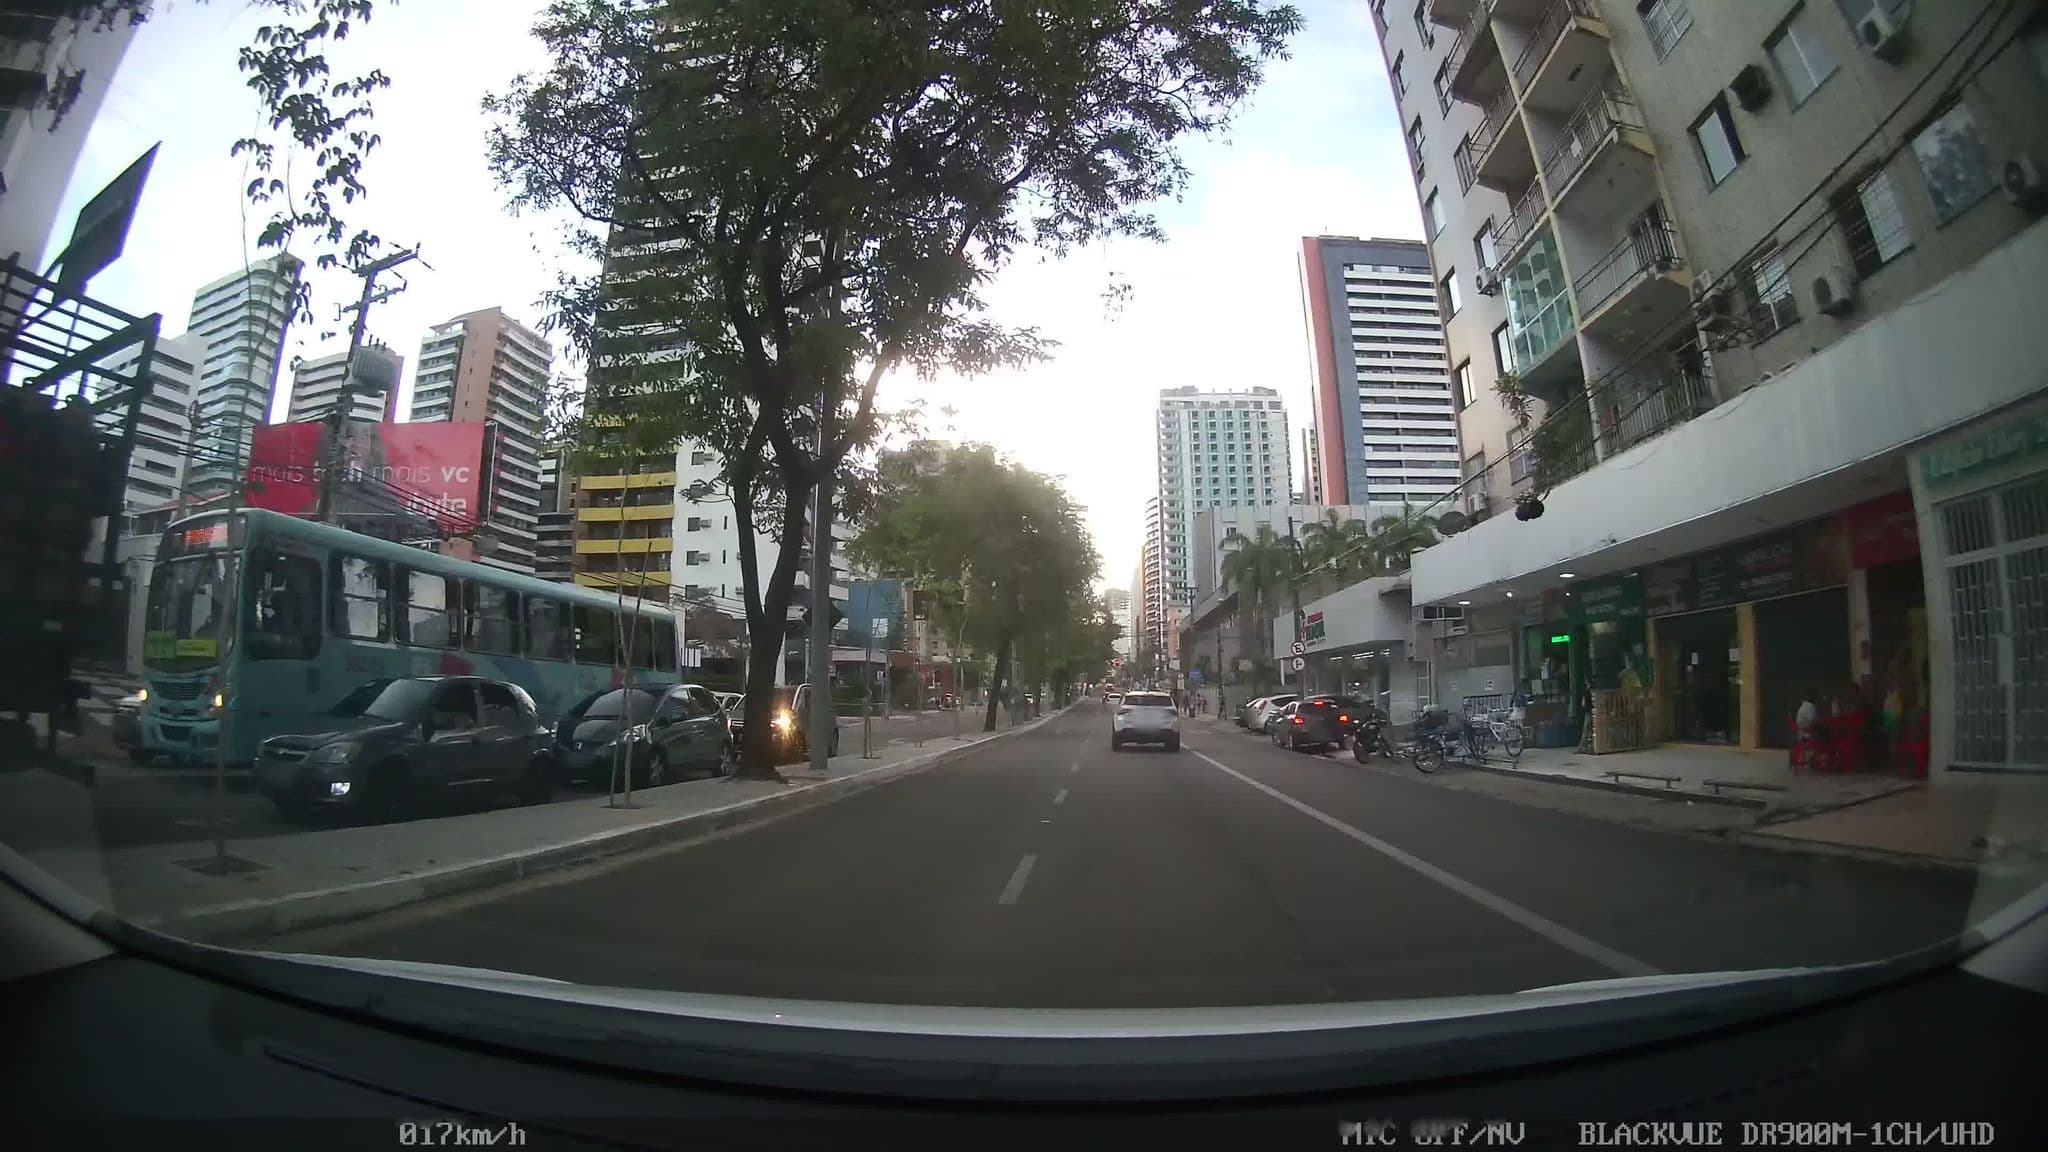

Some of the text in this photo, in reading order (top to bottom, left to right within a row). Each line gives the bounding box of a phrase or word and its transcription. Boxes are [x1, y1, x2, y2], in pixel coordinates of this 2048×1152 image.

[312, 460, 363, 482] tch
[373, 465, 431, 483] mais
[440, 466, 470, 483] vc
